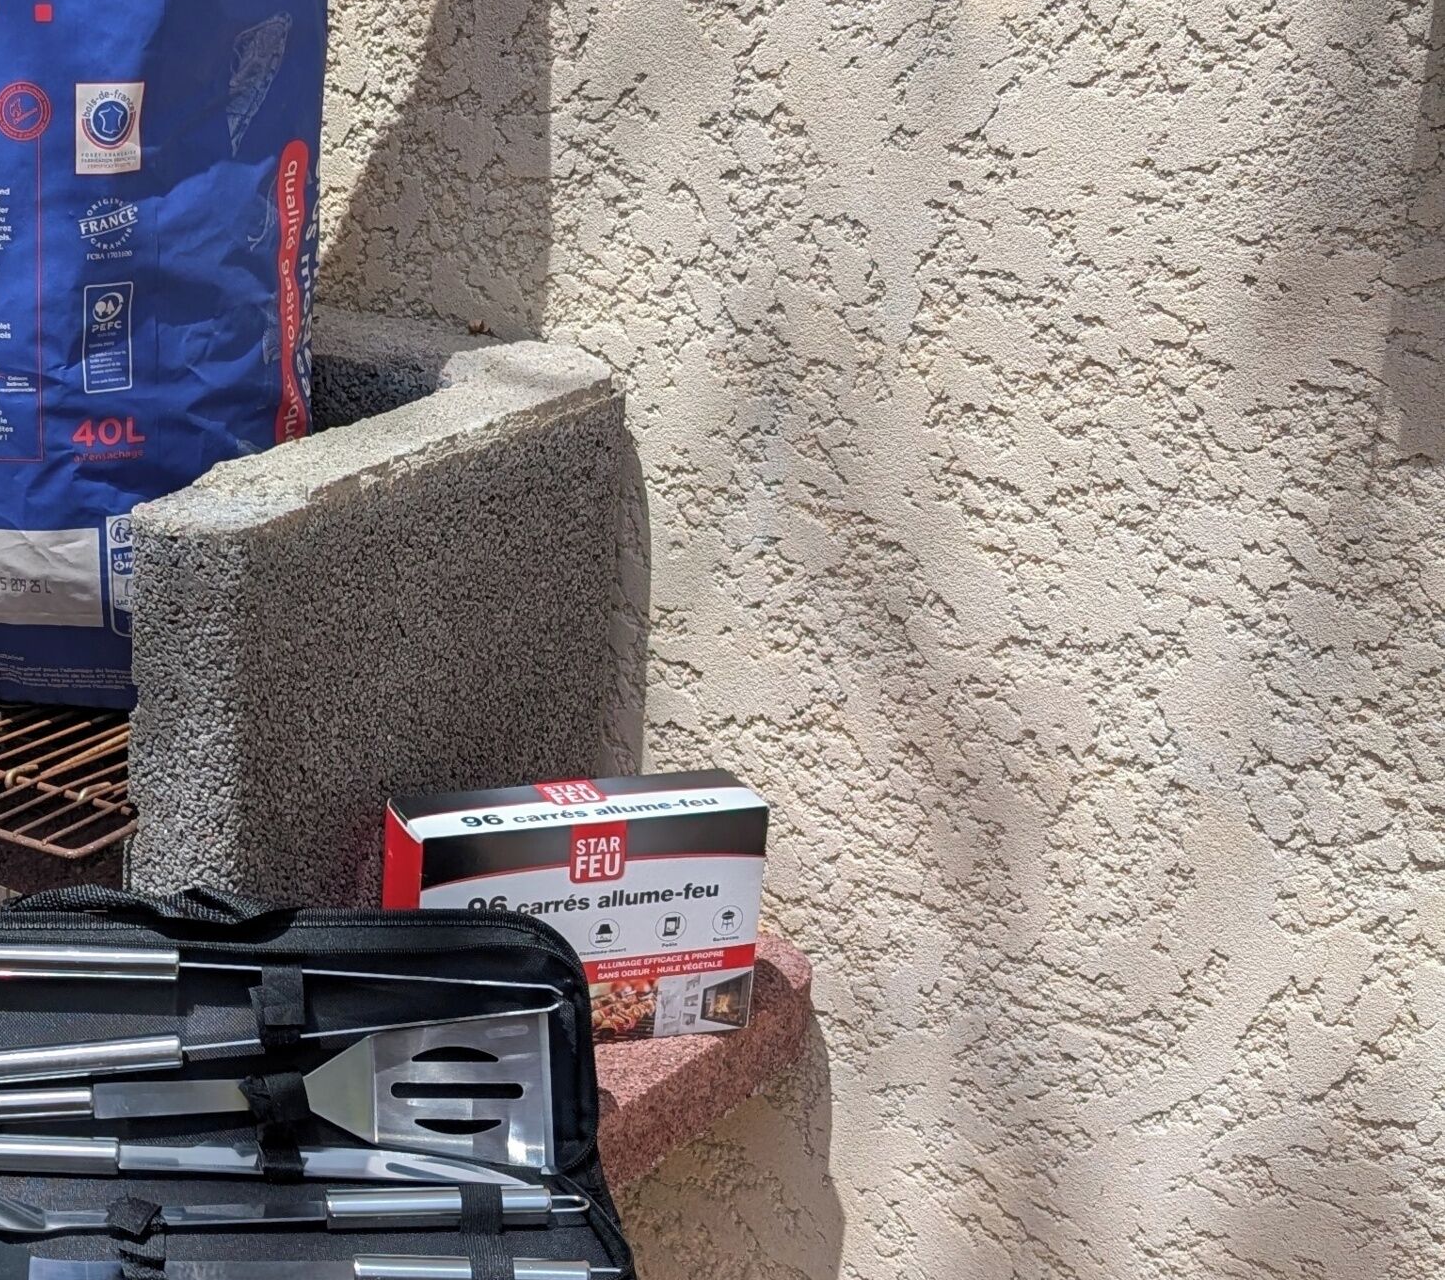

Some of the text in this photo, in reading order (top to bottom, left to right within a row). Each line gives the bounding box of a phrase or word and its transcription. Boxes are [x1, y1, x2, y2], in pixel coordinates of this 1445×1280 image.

[284, 160, 299, 250] qualité
[92, 320, 122, 333] PEFC
[72, 416, 146, 447] 40L
[543, 783, 591, 794] STAR
[551, 791, 601, 805] FEU
[461, 796, 719, 827] 96 carrés allume-feu
[576, 836, 620, 855] STAR
[575, 852, 621, 879] FEU
[468, 883, 719, 916] 96 carrés allume-feu
[597, 958, 642, 970] ALLUMAGE
[643, 955, 682, 966] EFFICACE
[692, 950, 725, 960] PROPRE
[597, 960, 723, 980] SANS ODEUR HUILE VÉGÉTALE
